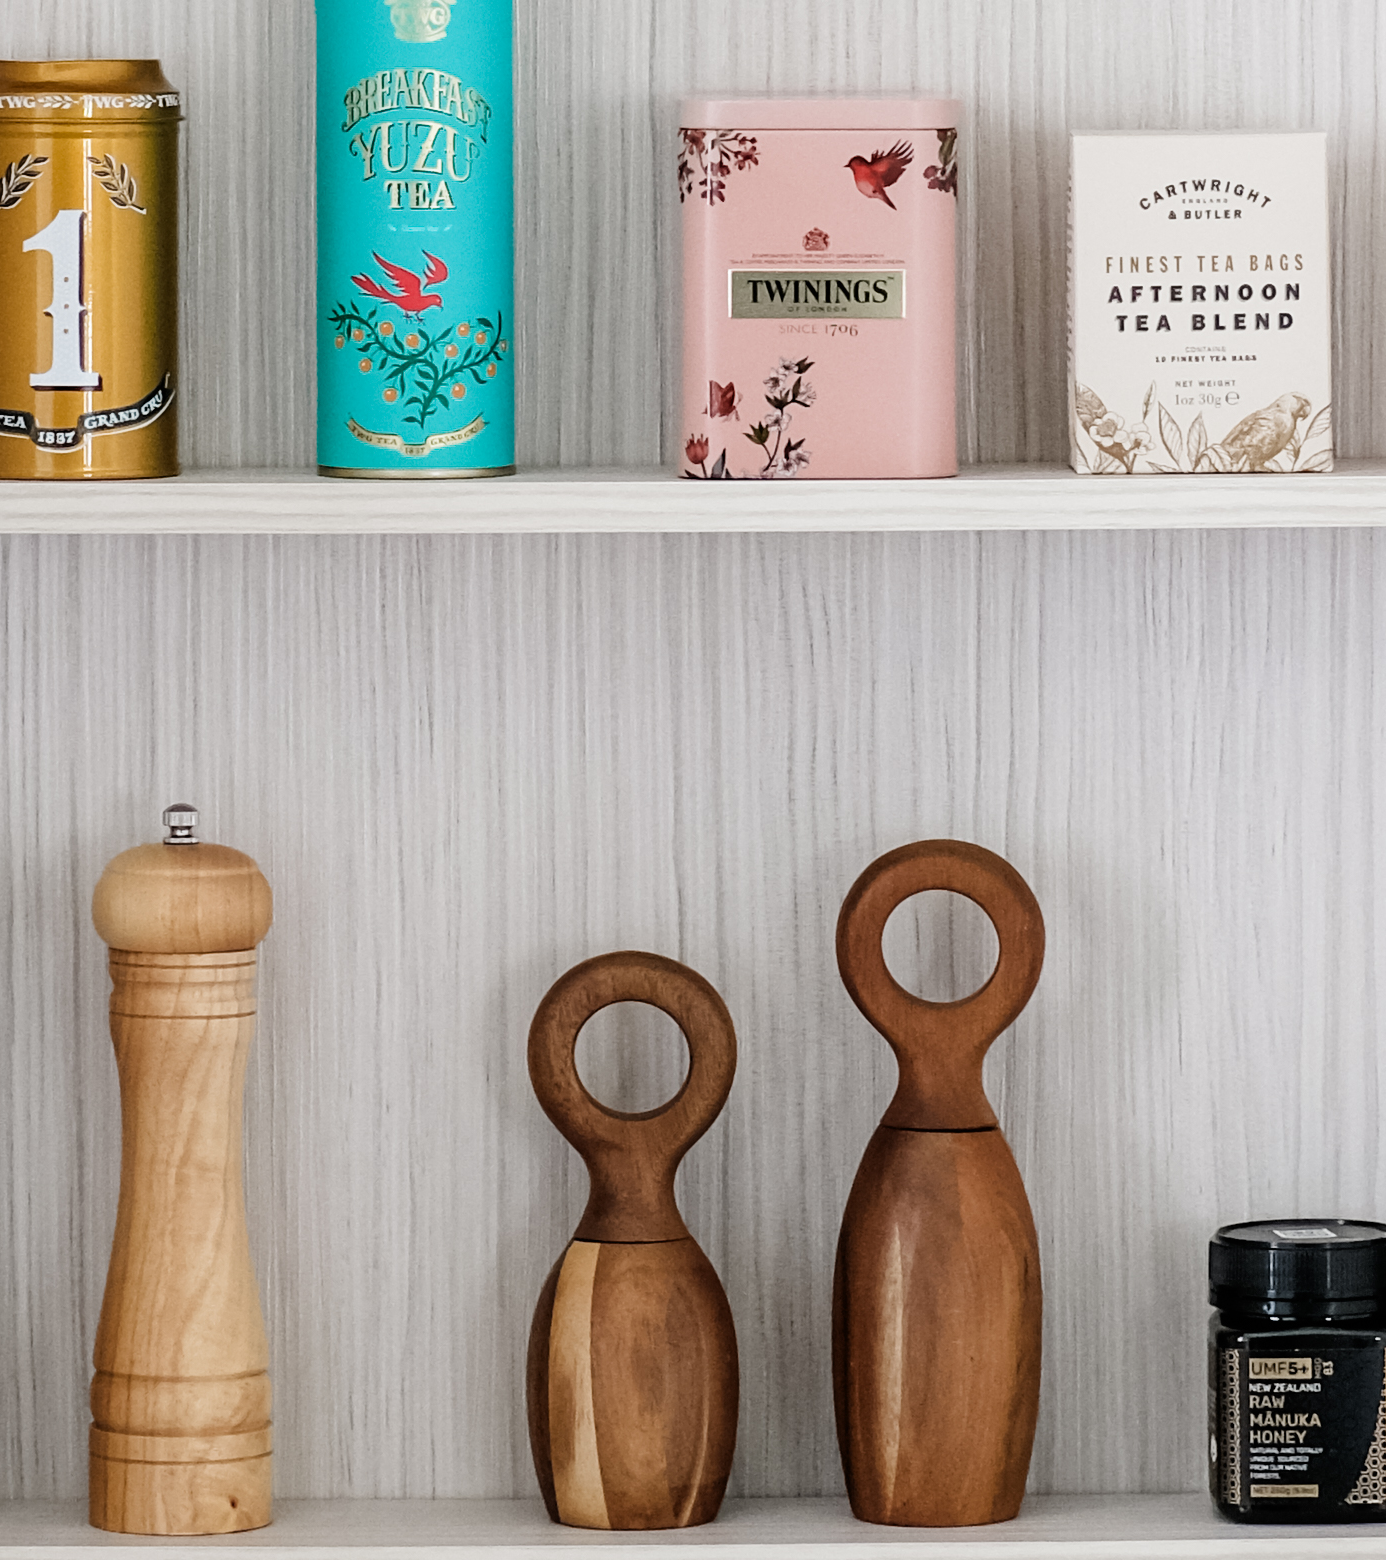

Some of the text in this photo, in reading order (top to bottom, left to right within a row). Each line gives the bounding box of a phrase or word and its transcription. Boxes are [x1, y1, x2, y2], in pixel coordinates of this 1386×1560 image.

[79, 94, 124, 109] TWG
[342, 67, 492, 144] BREAKFAST
[349, 119, 480, 182] YUZU
[384, 180, 457, 211] TEA
[1139, 178, 1272, 211] CARTWRIGHT
[1168, 209, 1243, 220] & BUTLER
[1106, 253, 1304, 274] FINEST TEA BAGS
[22, 209, 102, 391] 1
[747, 279, 888, 304] TWININGS
[1108, 282, 1302, 304] AFTERNOON
[779, 323, 859, 338] SINCE 1706
[1115, 312, 1294, 333] TEA BLEND
[1155, 354, 1257, 363] 10 FINEST TEA BAGS
[1198, 379, 1236, 387] WEIGHT
[84, 390, 164, 430] GRAND CRU
[1249, 1382, 1321, 1392] NEW ZEALAND
[1249, 1395, 1285, 1409] RAW
[1249, 1430, 1307, 1444] HONEY
